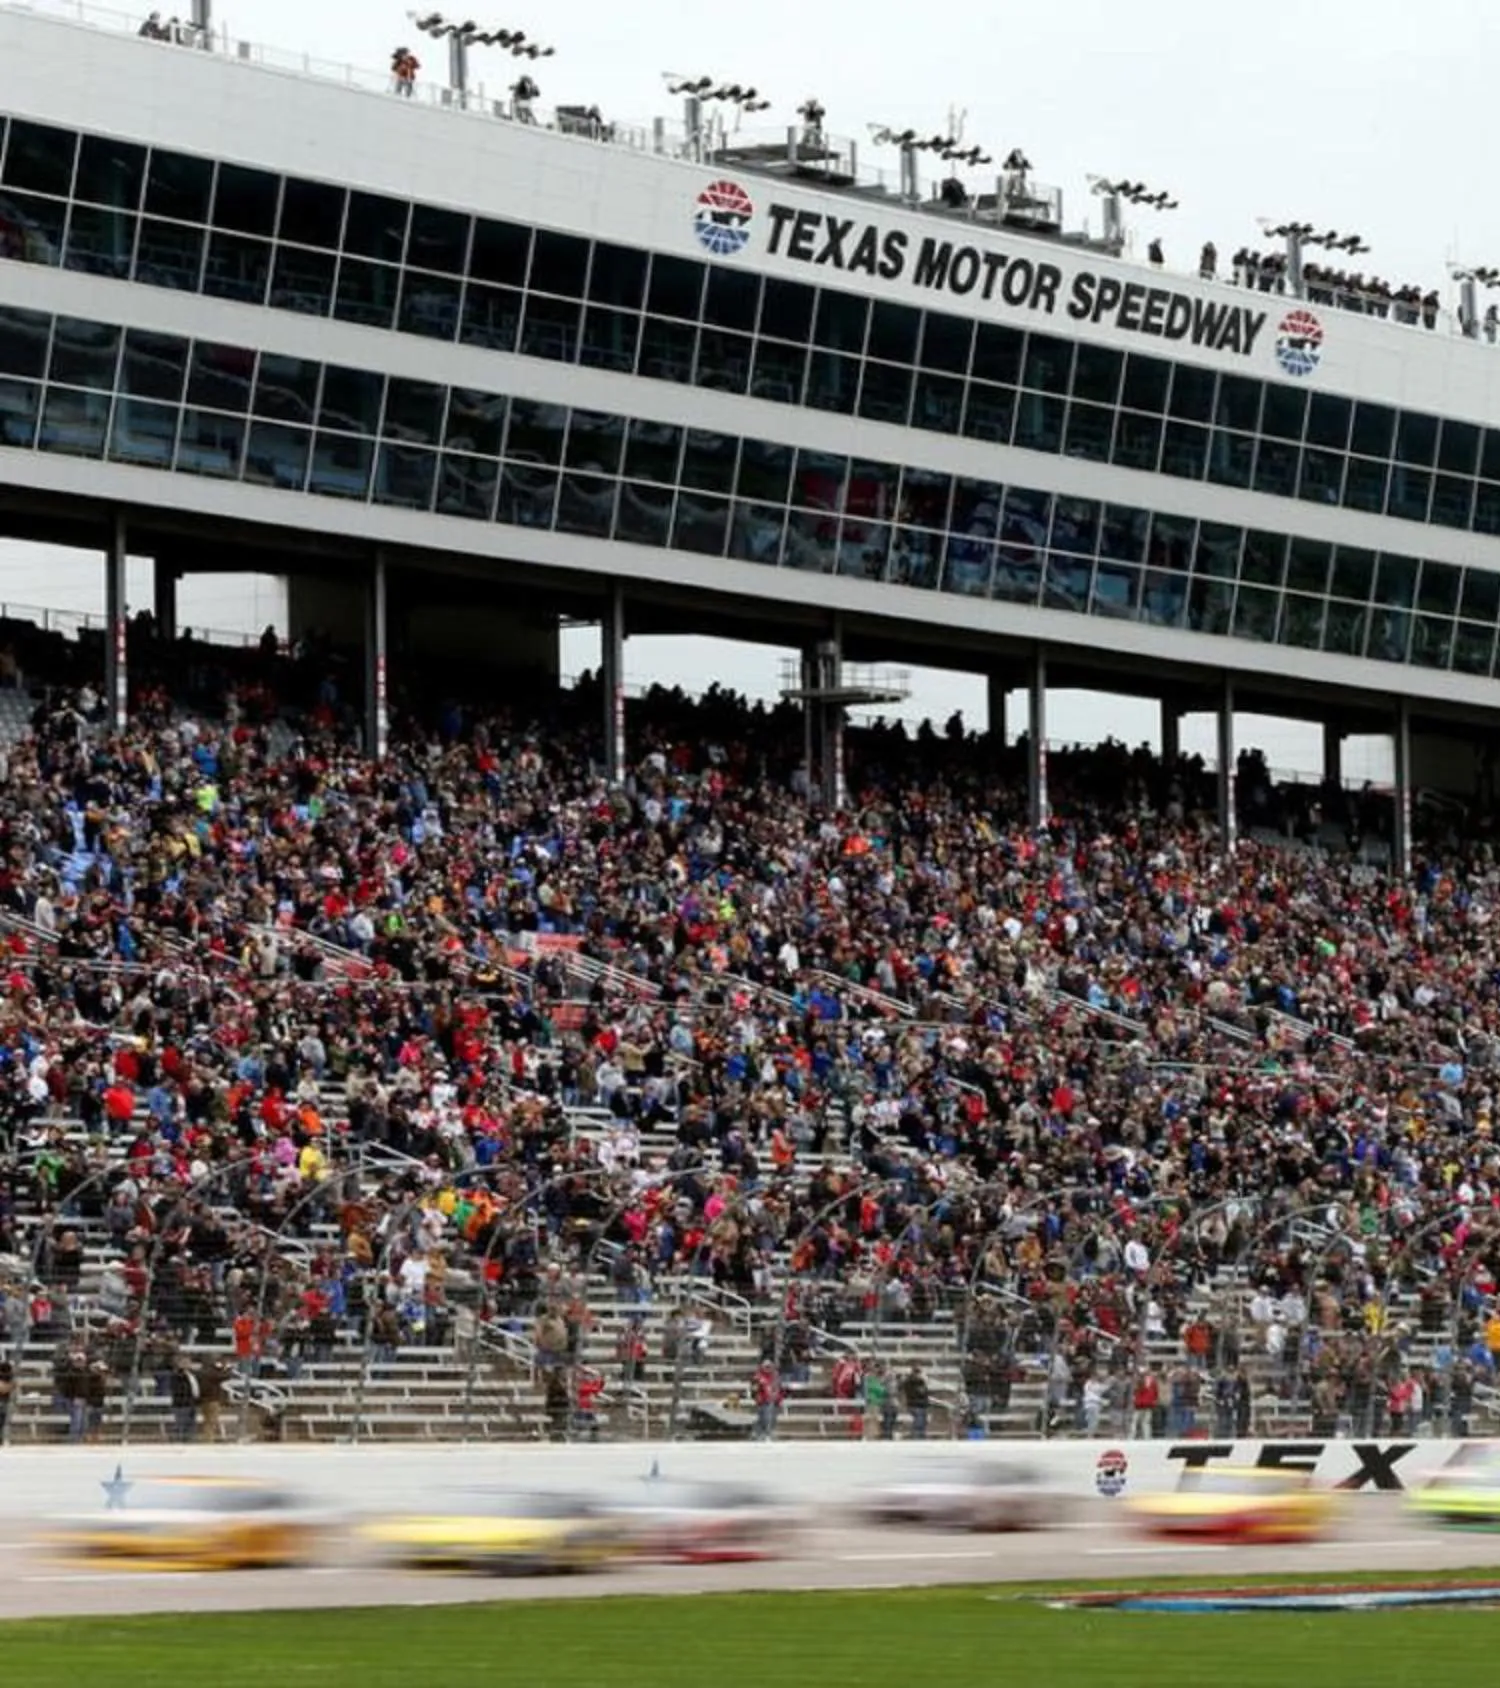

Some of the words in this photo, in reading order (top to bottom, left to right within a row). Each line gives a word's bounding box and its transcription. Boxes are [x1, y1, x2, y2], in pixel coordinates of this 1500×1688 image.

[766, 203, 908, 280] TEXAS
[912, 237, 1062, 314] MOTOR
[1066, 271, 1267, 355] SPEEDWAY
[1167, 1444, 1418, 1490] TEX
